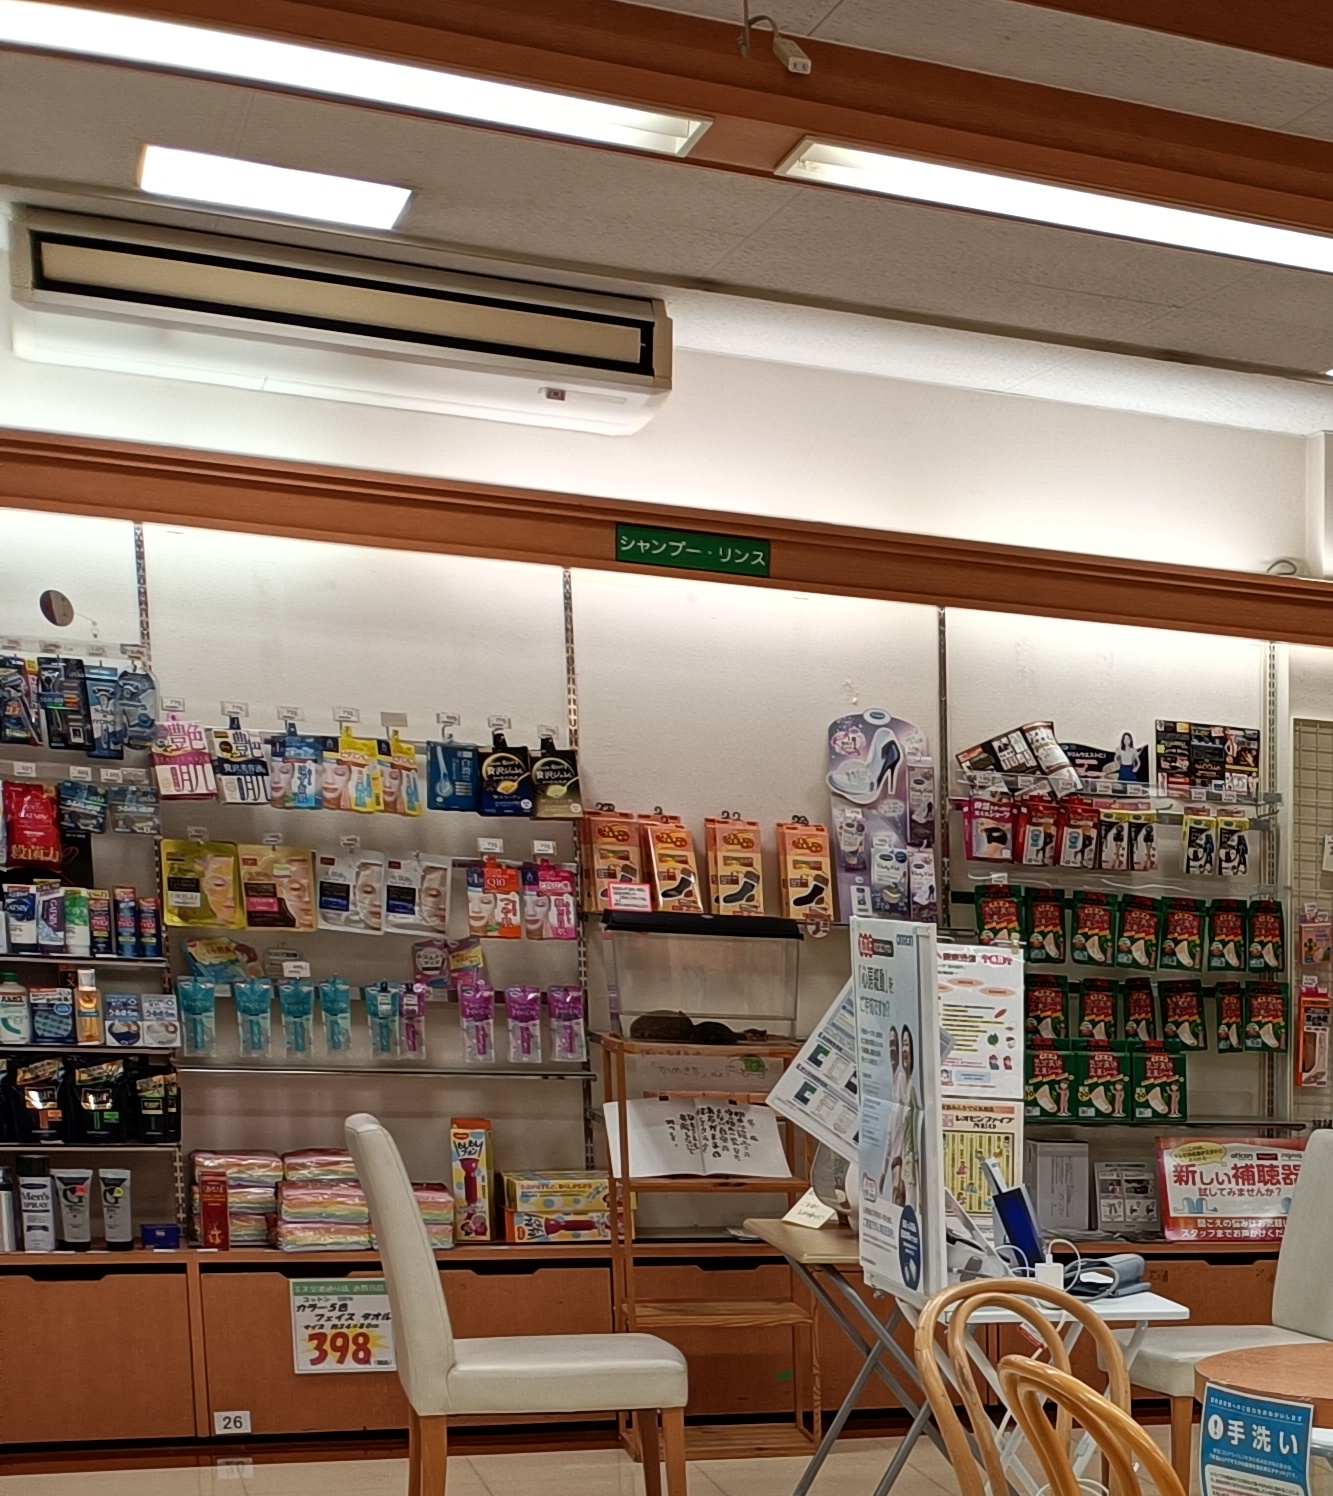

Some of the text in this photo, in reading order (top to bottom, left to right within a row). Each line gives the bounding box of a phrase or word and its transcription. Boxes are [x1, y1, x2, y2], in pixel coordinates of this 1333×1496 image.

[619, 534, 765, 566] シャンプー・リンス
[1172, 1164, 1301, 1186] 新しい補聴器
[1198, 1187, 1281, 1197] 試してみませんか?
[308, 1331, 372, 1366] 398
[221, 1415, 244, 1431] 26
[1228, 1419, 1298, 1454] 手洗い
